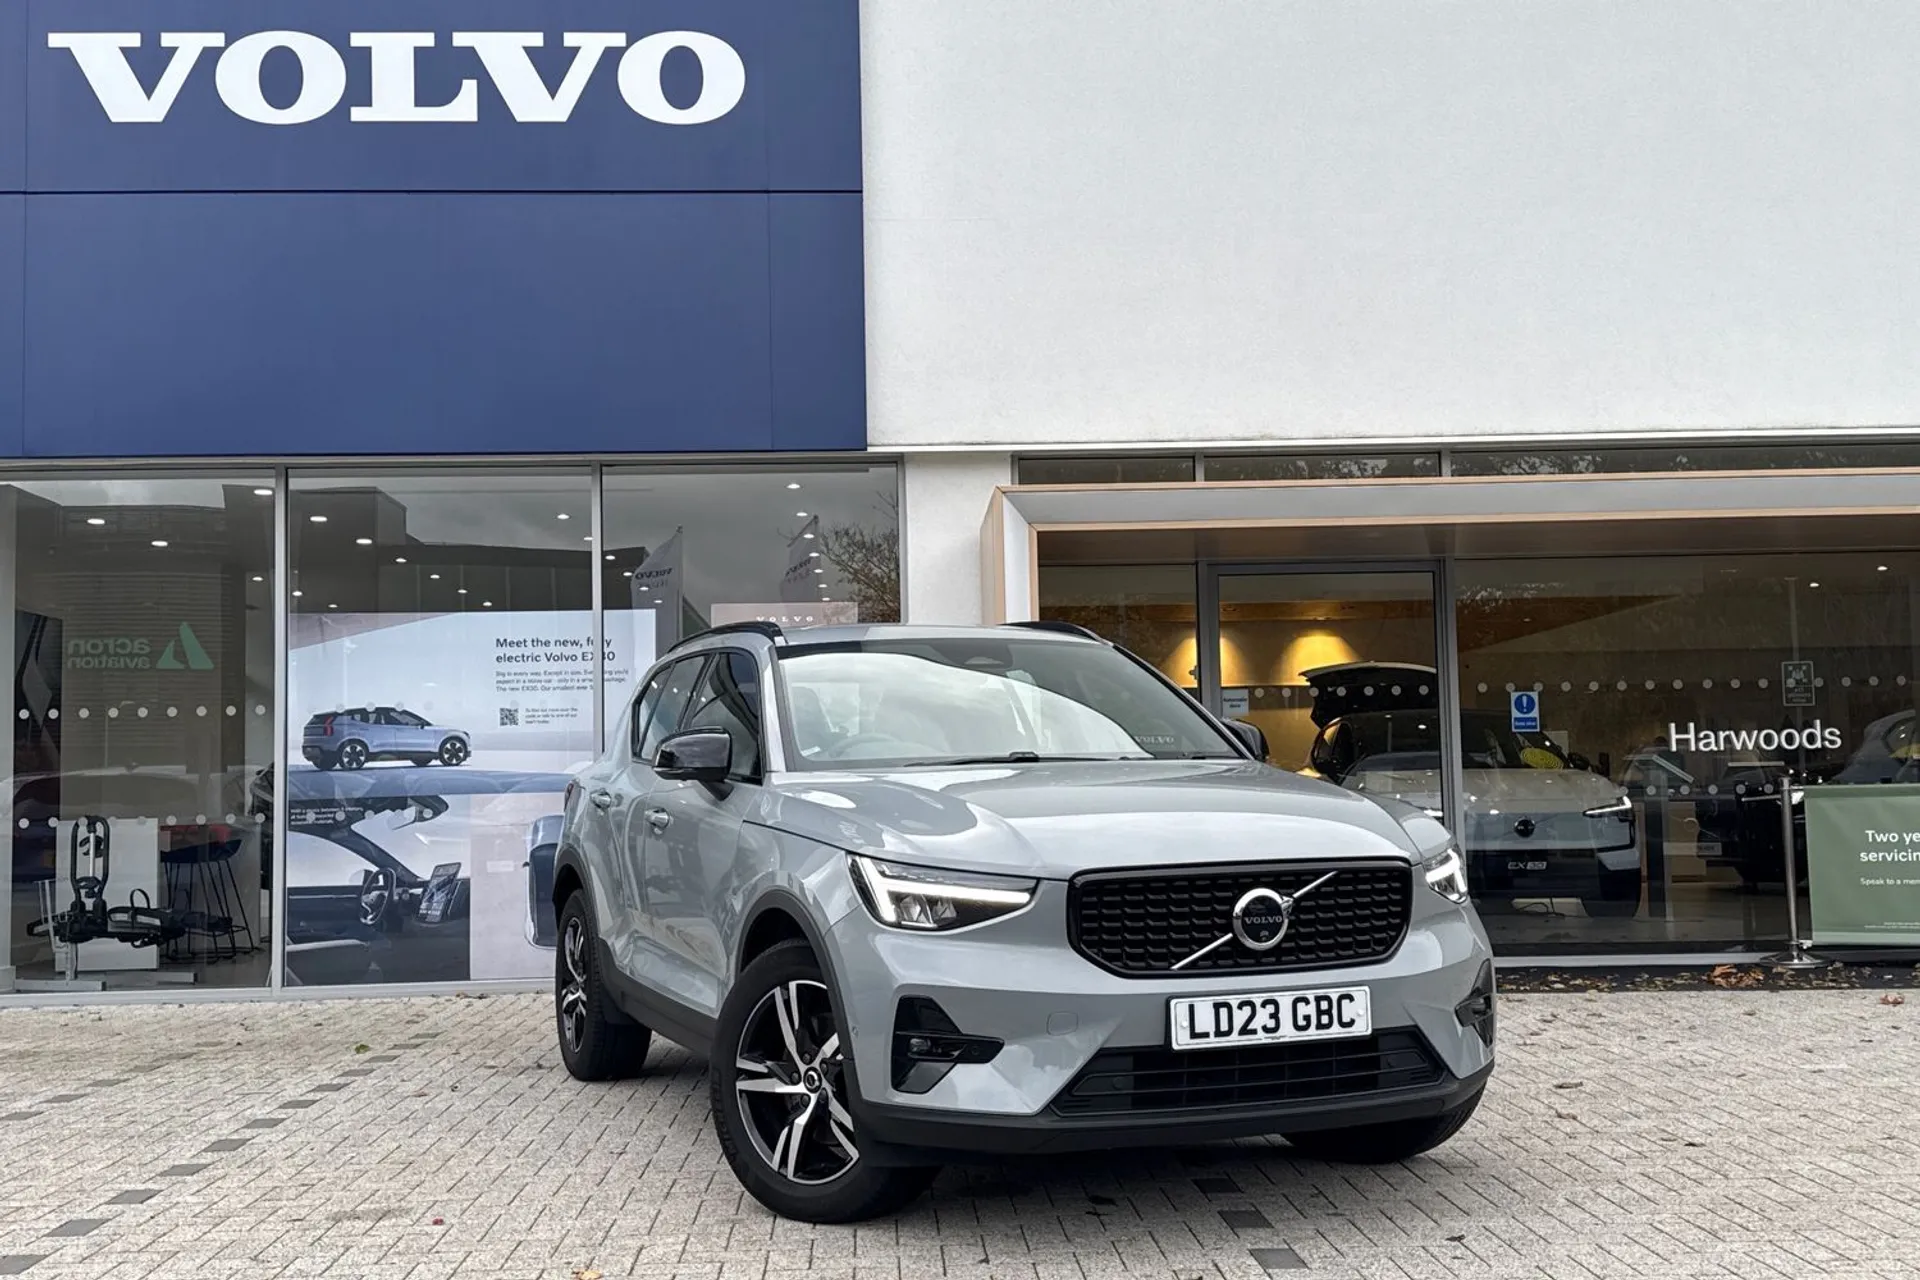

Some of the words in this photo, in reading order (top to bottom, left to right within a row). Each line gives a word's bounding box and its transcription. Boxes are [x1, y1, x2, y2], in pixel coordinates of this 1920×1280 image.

[47, 30, 746, 125] VOLVO
[495, 638, 528, 648] Meet
[531, 637, 551, 648] the
[554, 639, 583, 649] new,
[495, 652, 541, 663] electric
[544, 651, 578, 662] Volvo
[1668, 719, 1842, 752] Harwoods
[1865, 829, 1899, 843] Two
[1860, 877, 1884, 886] Speak
[1243, 915, 1283, 925] VOLVO
[1187, 998, 1280, 1040] LD23
[1291, 993, 1356, 1032] GBC
